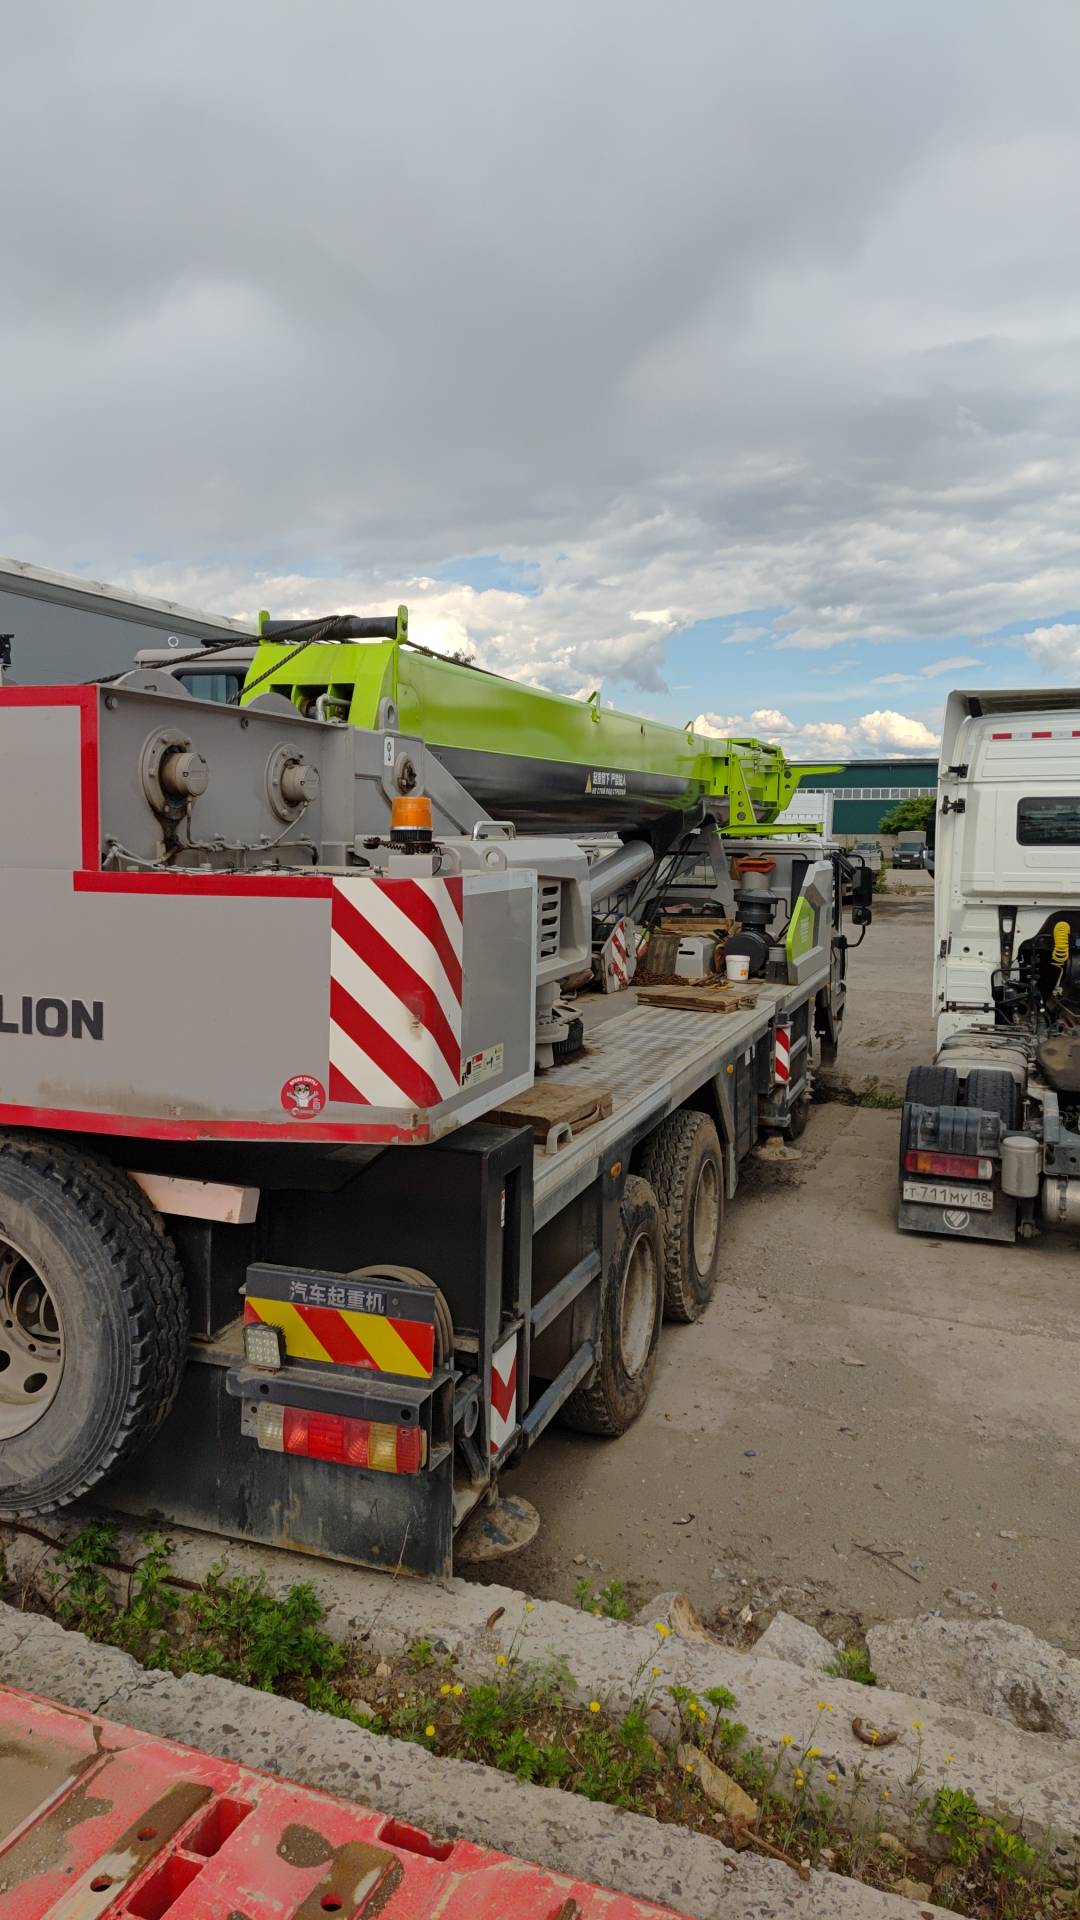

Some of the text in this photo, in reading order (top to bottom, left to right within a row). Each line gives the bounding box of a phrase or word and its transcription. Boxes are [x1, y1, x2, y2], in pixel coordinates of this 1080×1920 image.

[0, 993, 104, 1040] LION
[289, 1281, 384, 1313] 汽车起重机
